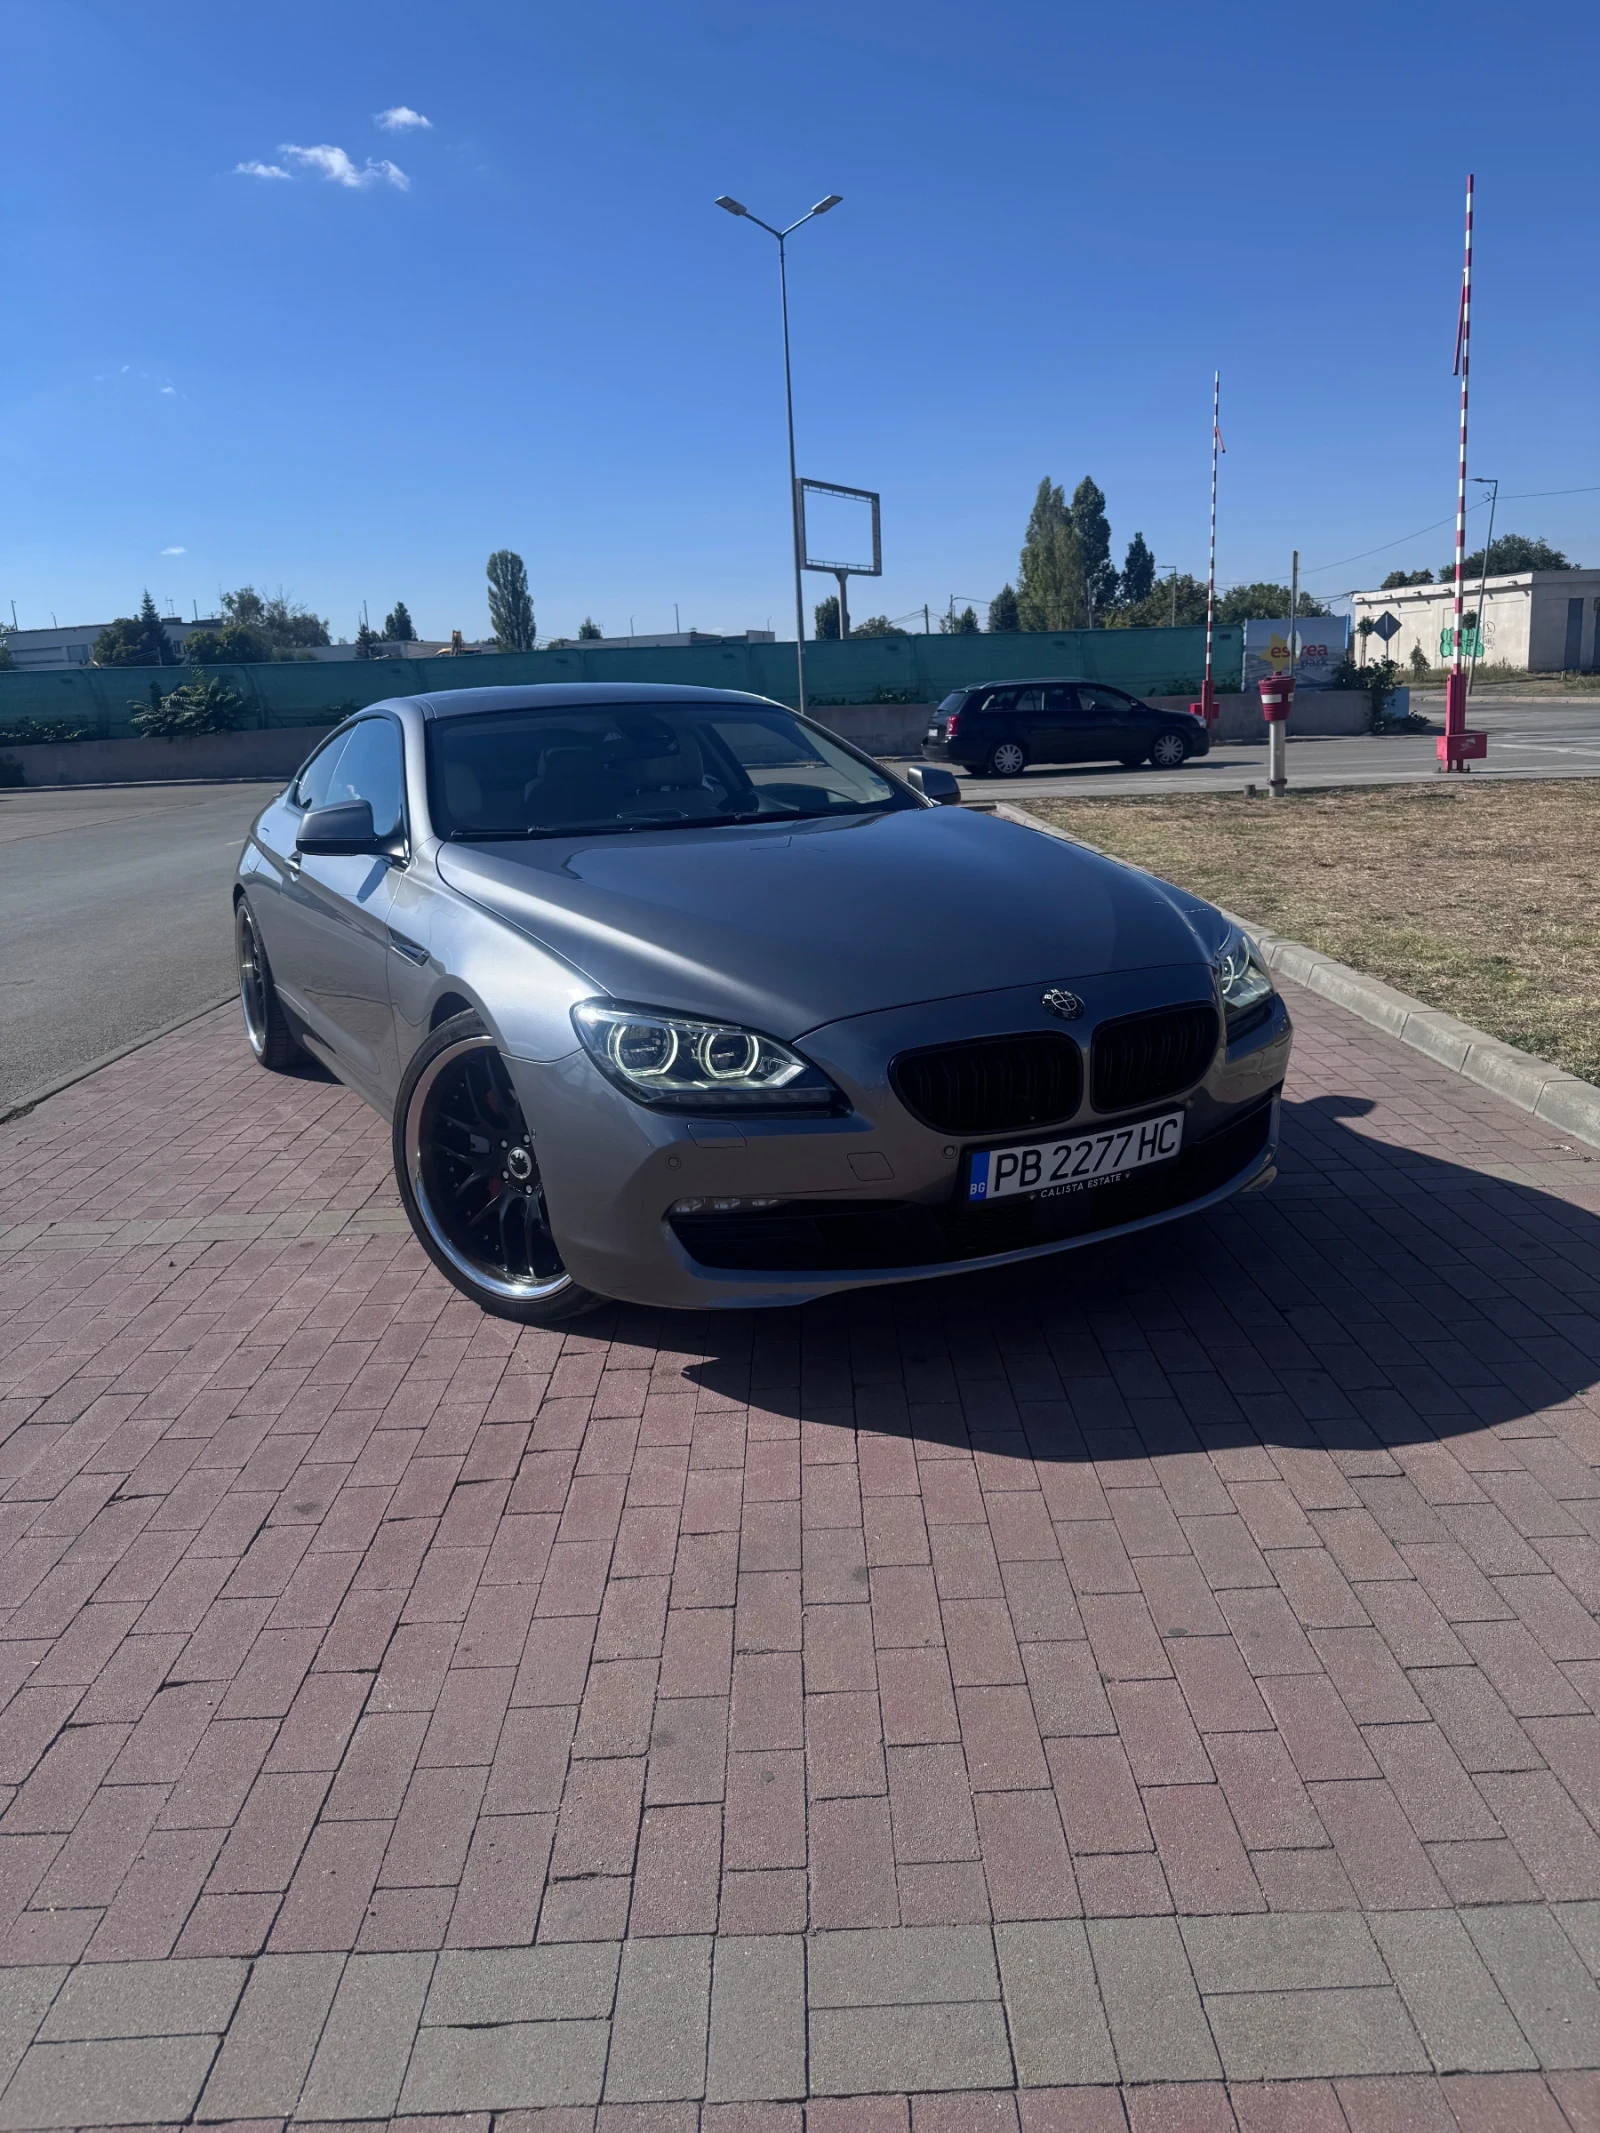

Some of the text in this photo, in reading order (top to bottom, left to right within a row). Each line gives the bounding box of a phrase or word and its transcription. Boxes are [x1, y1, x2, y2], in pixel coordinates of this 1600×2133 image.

[1271, 644, 1328, 658] esrea
[1301, 656, 1328, 668] park
[994, 1119, 1178, 1192] PB 2277 HC
[970, 1182, 986, 1195] BG
[1040, 1173, 1122, 1198] CALISTA ESTATE
